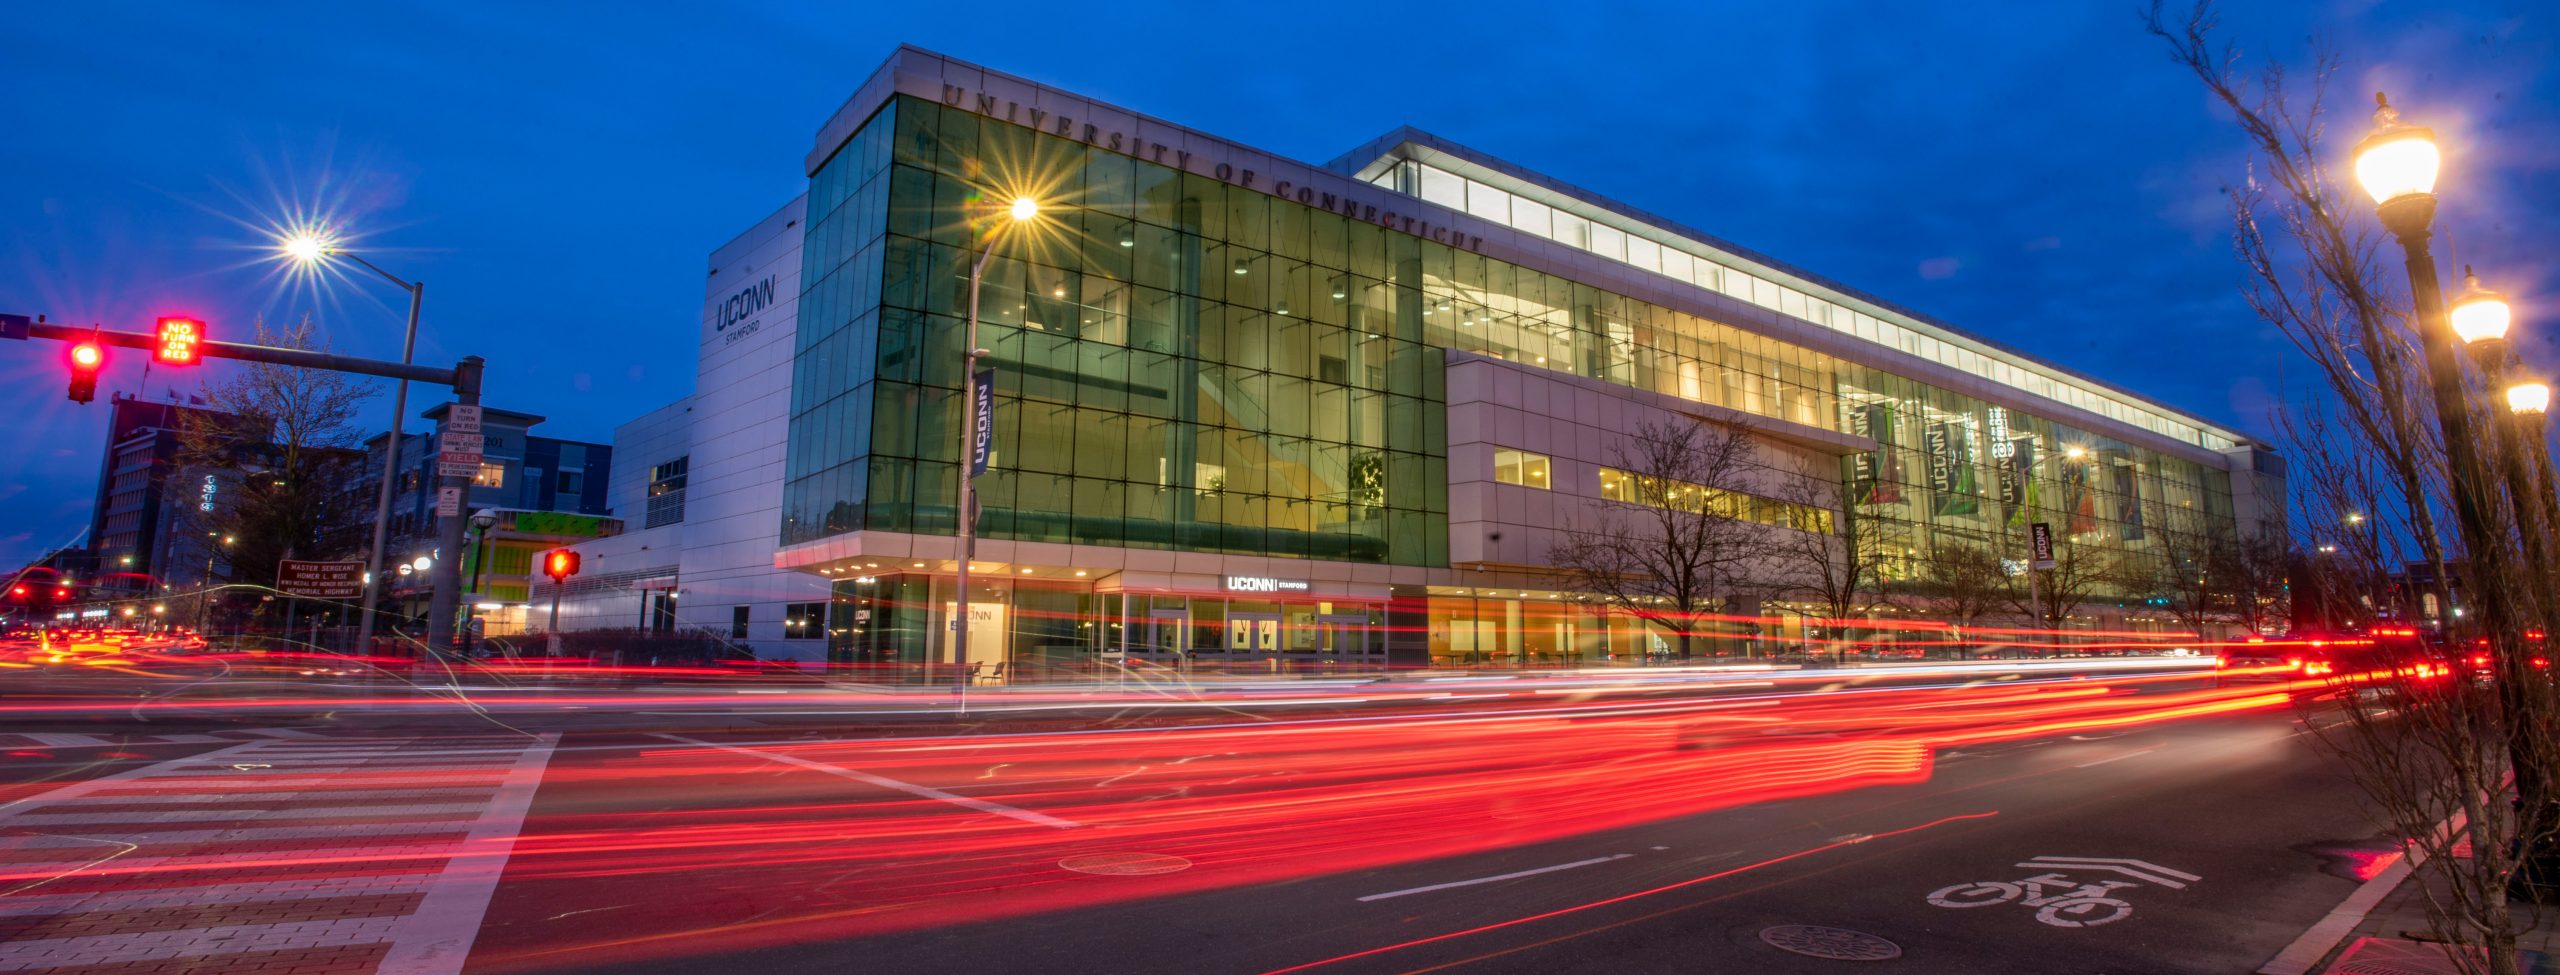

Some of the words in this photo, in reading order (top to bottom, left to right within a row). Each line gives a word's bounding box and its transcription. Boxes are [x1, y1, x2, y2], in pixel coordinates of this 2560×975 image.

[943, 83, 1192, 172] UNIVERSITY
[1215, 162, 1255, 186] OF
[1276, 181, 1484, 250] CONNECTICUT
[717, 274, 776, 332] UCONN
[168, 322, 191, 334] NO
[725, 320, 760, 345] STAMFORD
[161, 332, 195, 344] TURN
[168, 341, 185, 350] ON
[163, 349, 189, 359] RED
[975, 384, 988, 464] UCONN
[445, 433, 465, 441] STATE
[484, 437, 503, 448] 201
[446, 453, 478, 463] YIELD
[1932, 429, 1950, 493] UCONN
[2036, 526, 2048, 559] UCONN
[321, 564, 355, 572] SERGEANT
[296, 572, 320, 580] HOMER
[1227, 576, 1274, 592] UCONN
[1278, 581, 1308, 589] STAMFORD
[286, 587, 321, 595] MEMORIAL
[855, 609, 871, 620] UCONN
